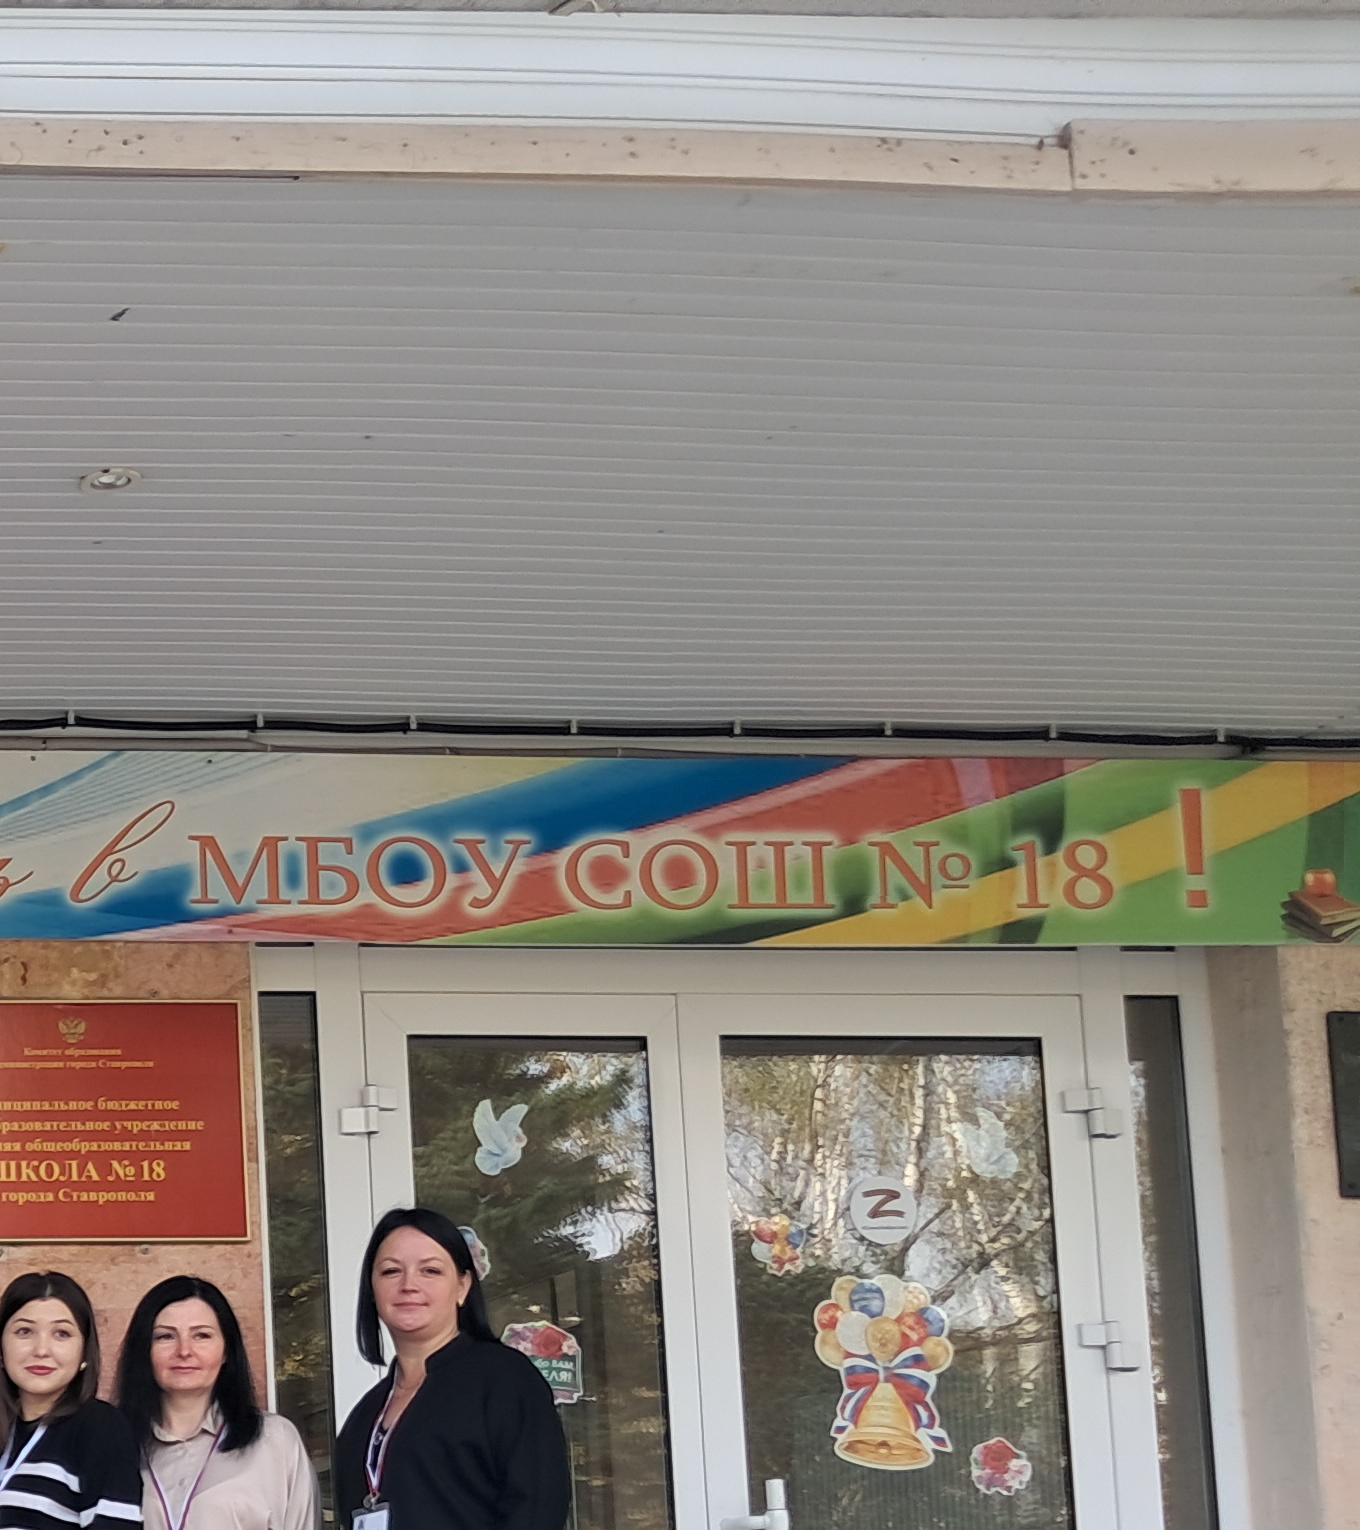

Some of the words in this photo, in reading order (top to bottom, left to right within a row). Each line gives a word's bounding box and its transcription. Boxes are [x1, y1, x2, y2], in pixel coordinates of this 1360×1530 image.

[69, 800, 175, 904] в
[187, 834, 532, 911] МБОУ
[564, 837, 835, 911] СОШ
[868, 839, 973, 911] №
[1012, 838, 1116, 912] 18
[97, 1096, 180, 1112] бюджетное
[114, 1120, 205, 1135] учреждение
[24, 1138, 192, 1155] общеобразовательная
[106, 1159, 137, 1182] №
[140, 1159, 167, 1182] 18
[0, 1190, 55, 1206] города
[57, 1187, 157, 1206] Ставрополя
